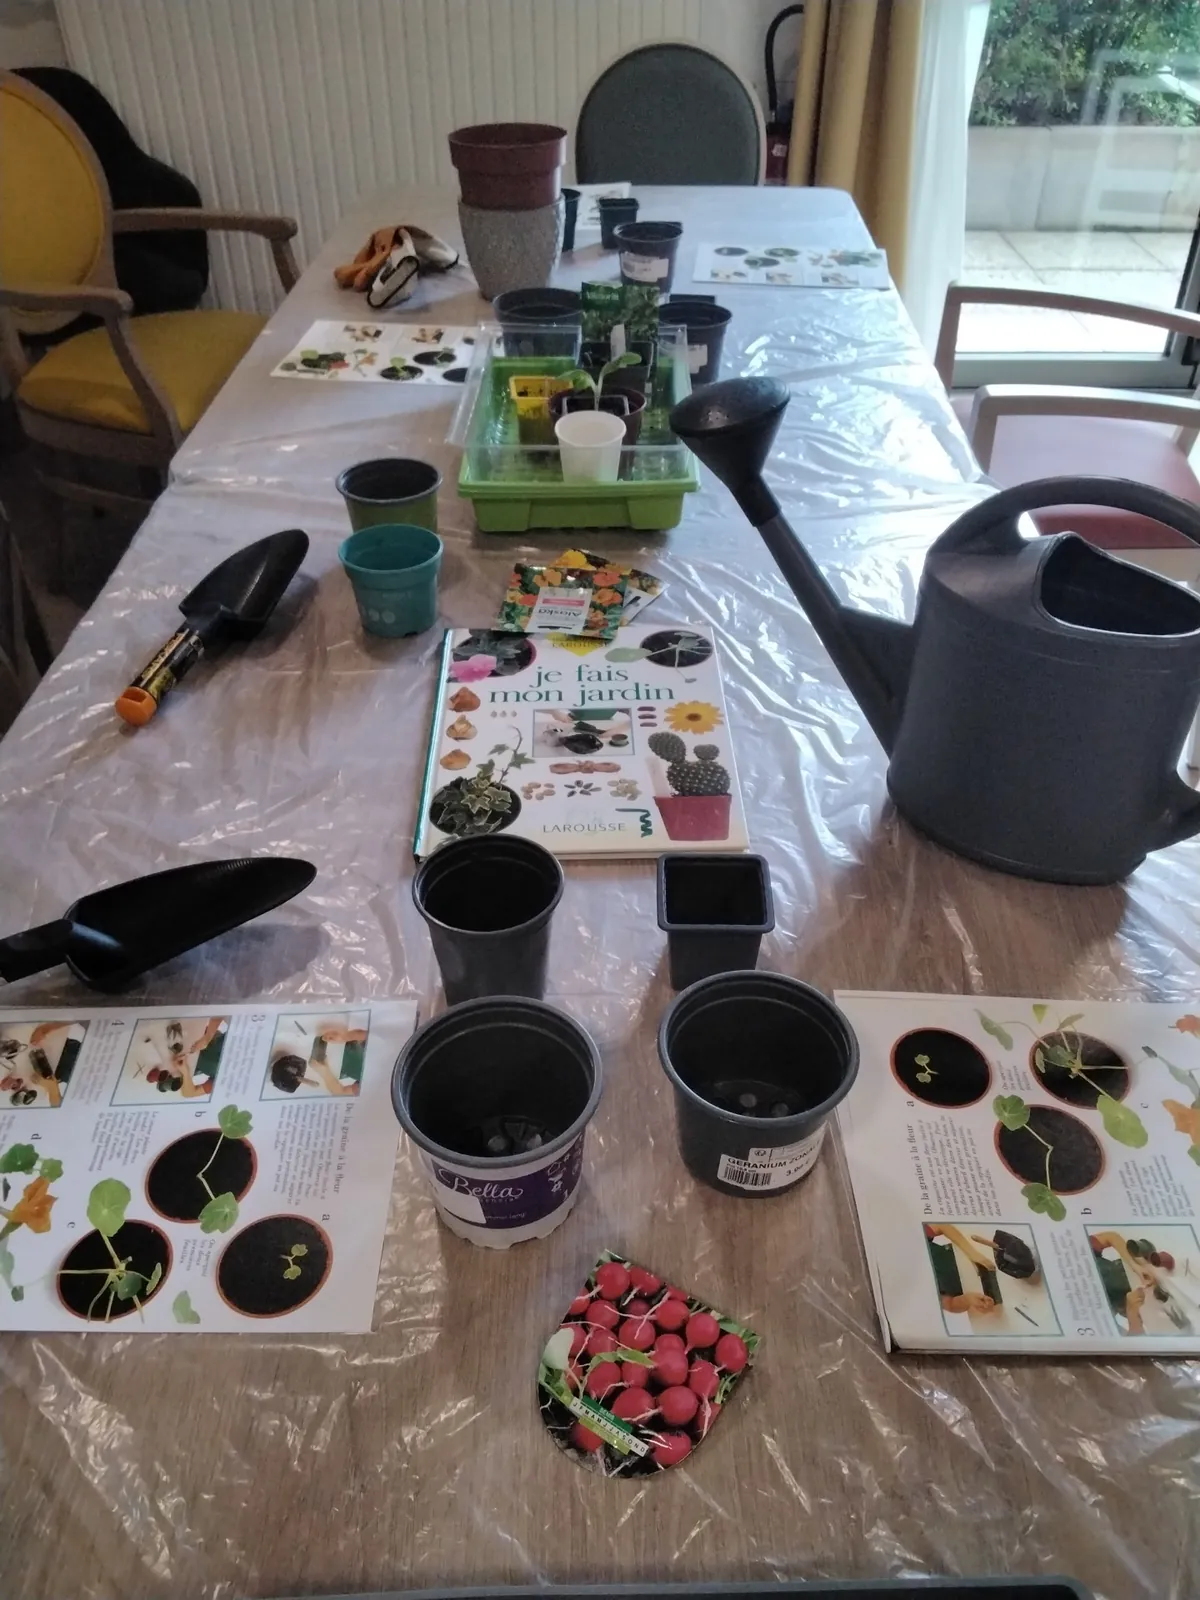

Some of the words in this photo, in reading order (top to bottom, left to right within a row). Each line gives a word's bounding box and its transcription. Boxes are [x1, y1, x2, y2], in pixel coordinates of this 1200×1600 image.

[529, 667, 563, 687] je
[575, 664, 629, 683] fais
[489, 688, 563, 704] mon
[572, 683, 675, 707] jardin
[543, 822, 627, 834] LAROUSSE
[727, 1157, 787, 1169] GERANIUM
[438, 1168, 525, 1200] Bella
